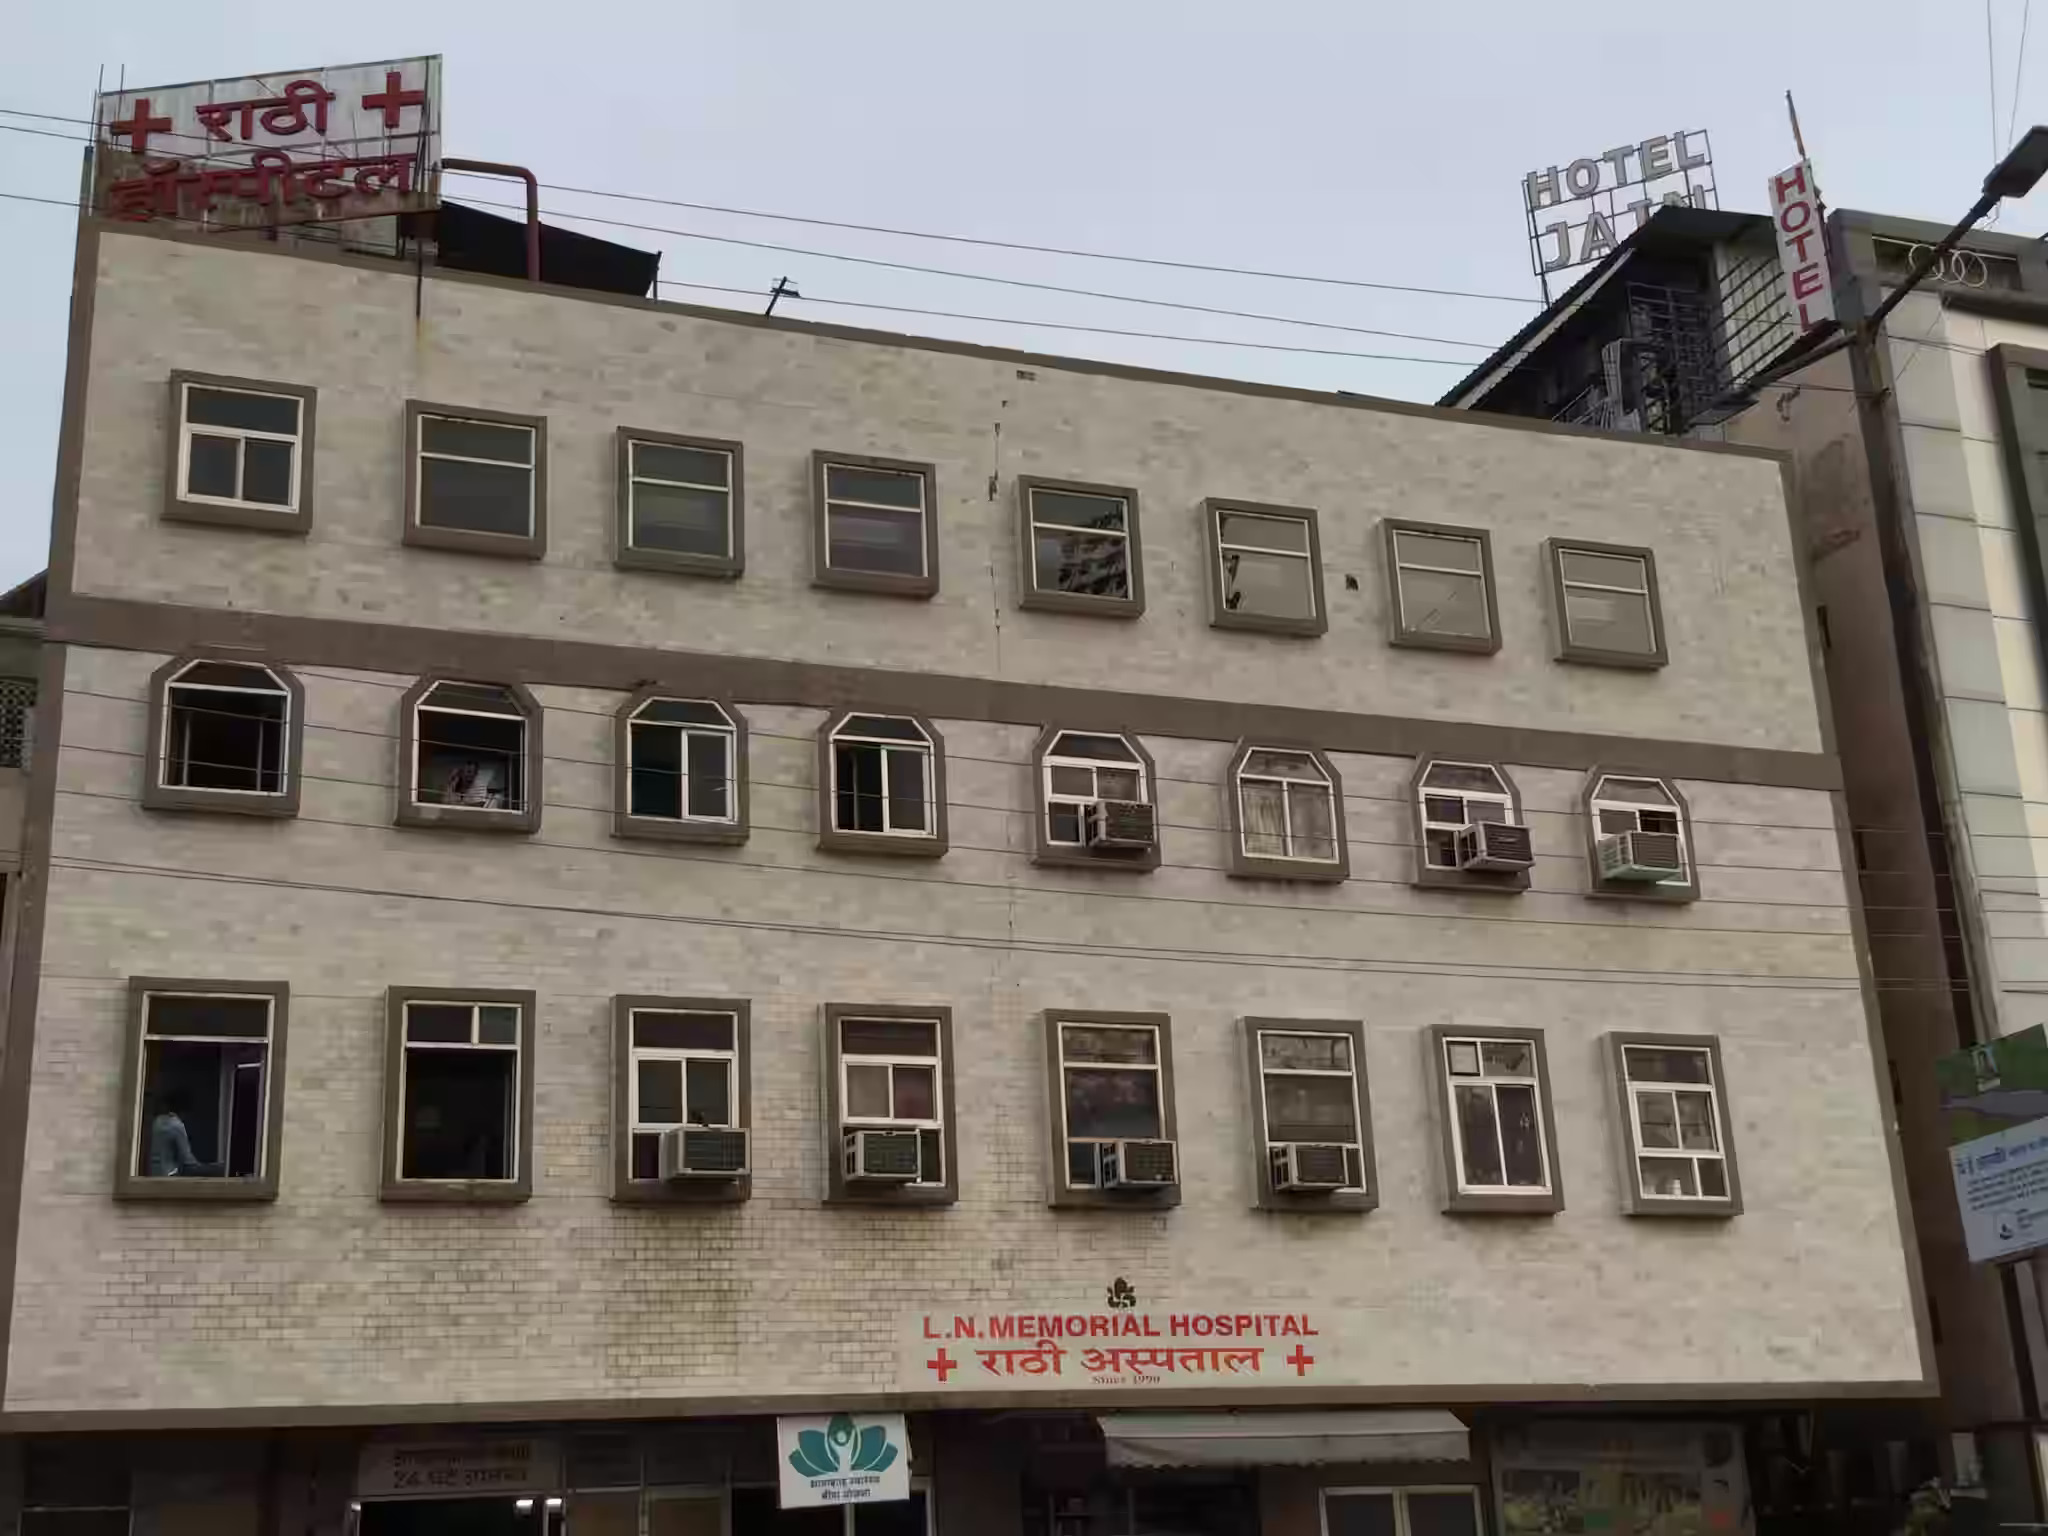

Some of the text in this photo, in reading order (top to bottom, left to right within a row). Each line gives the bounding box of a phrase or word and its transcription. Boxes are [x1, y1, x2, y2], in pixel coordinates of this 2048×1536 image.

[195, 79, 337, 142] राठी
[1527, 130, 1705, 209] HOTEL
[1774, 165, 1824, 333] HOTEL
[975, 1338, 1265, 1376] राठी अस्पताल
[1169, 1313, 1319, 1338] HOSPITAL
